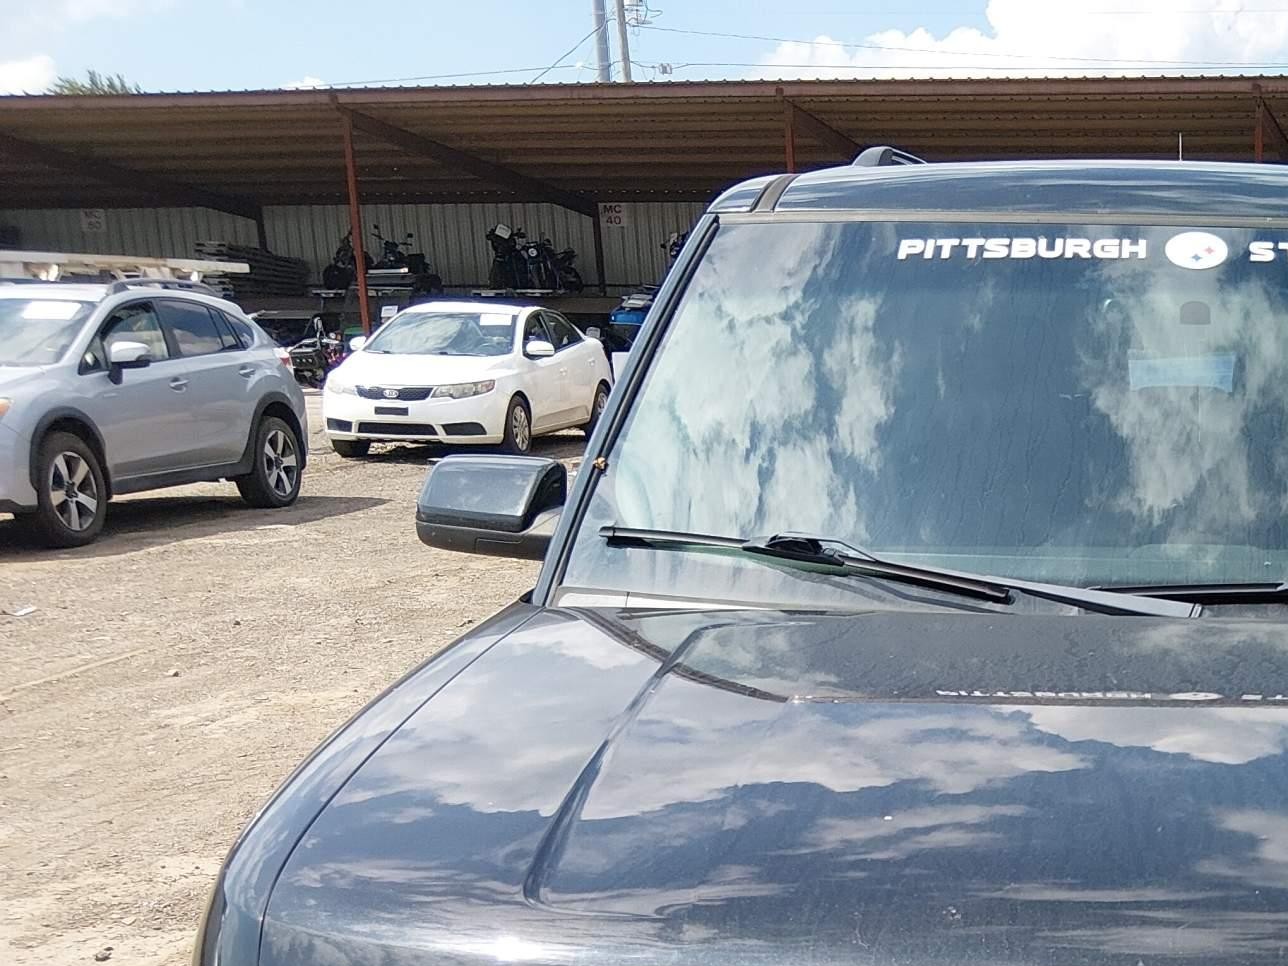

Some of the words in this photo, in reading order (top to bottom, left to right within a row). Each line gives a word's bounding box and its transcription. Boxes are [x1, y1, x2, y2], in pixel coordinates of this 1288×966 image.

[603, 204, 622, 214] MC
[606, 215, 622, 226] 40
[897, 238, 1147, 260] PITTSBURGH
